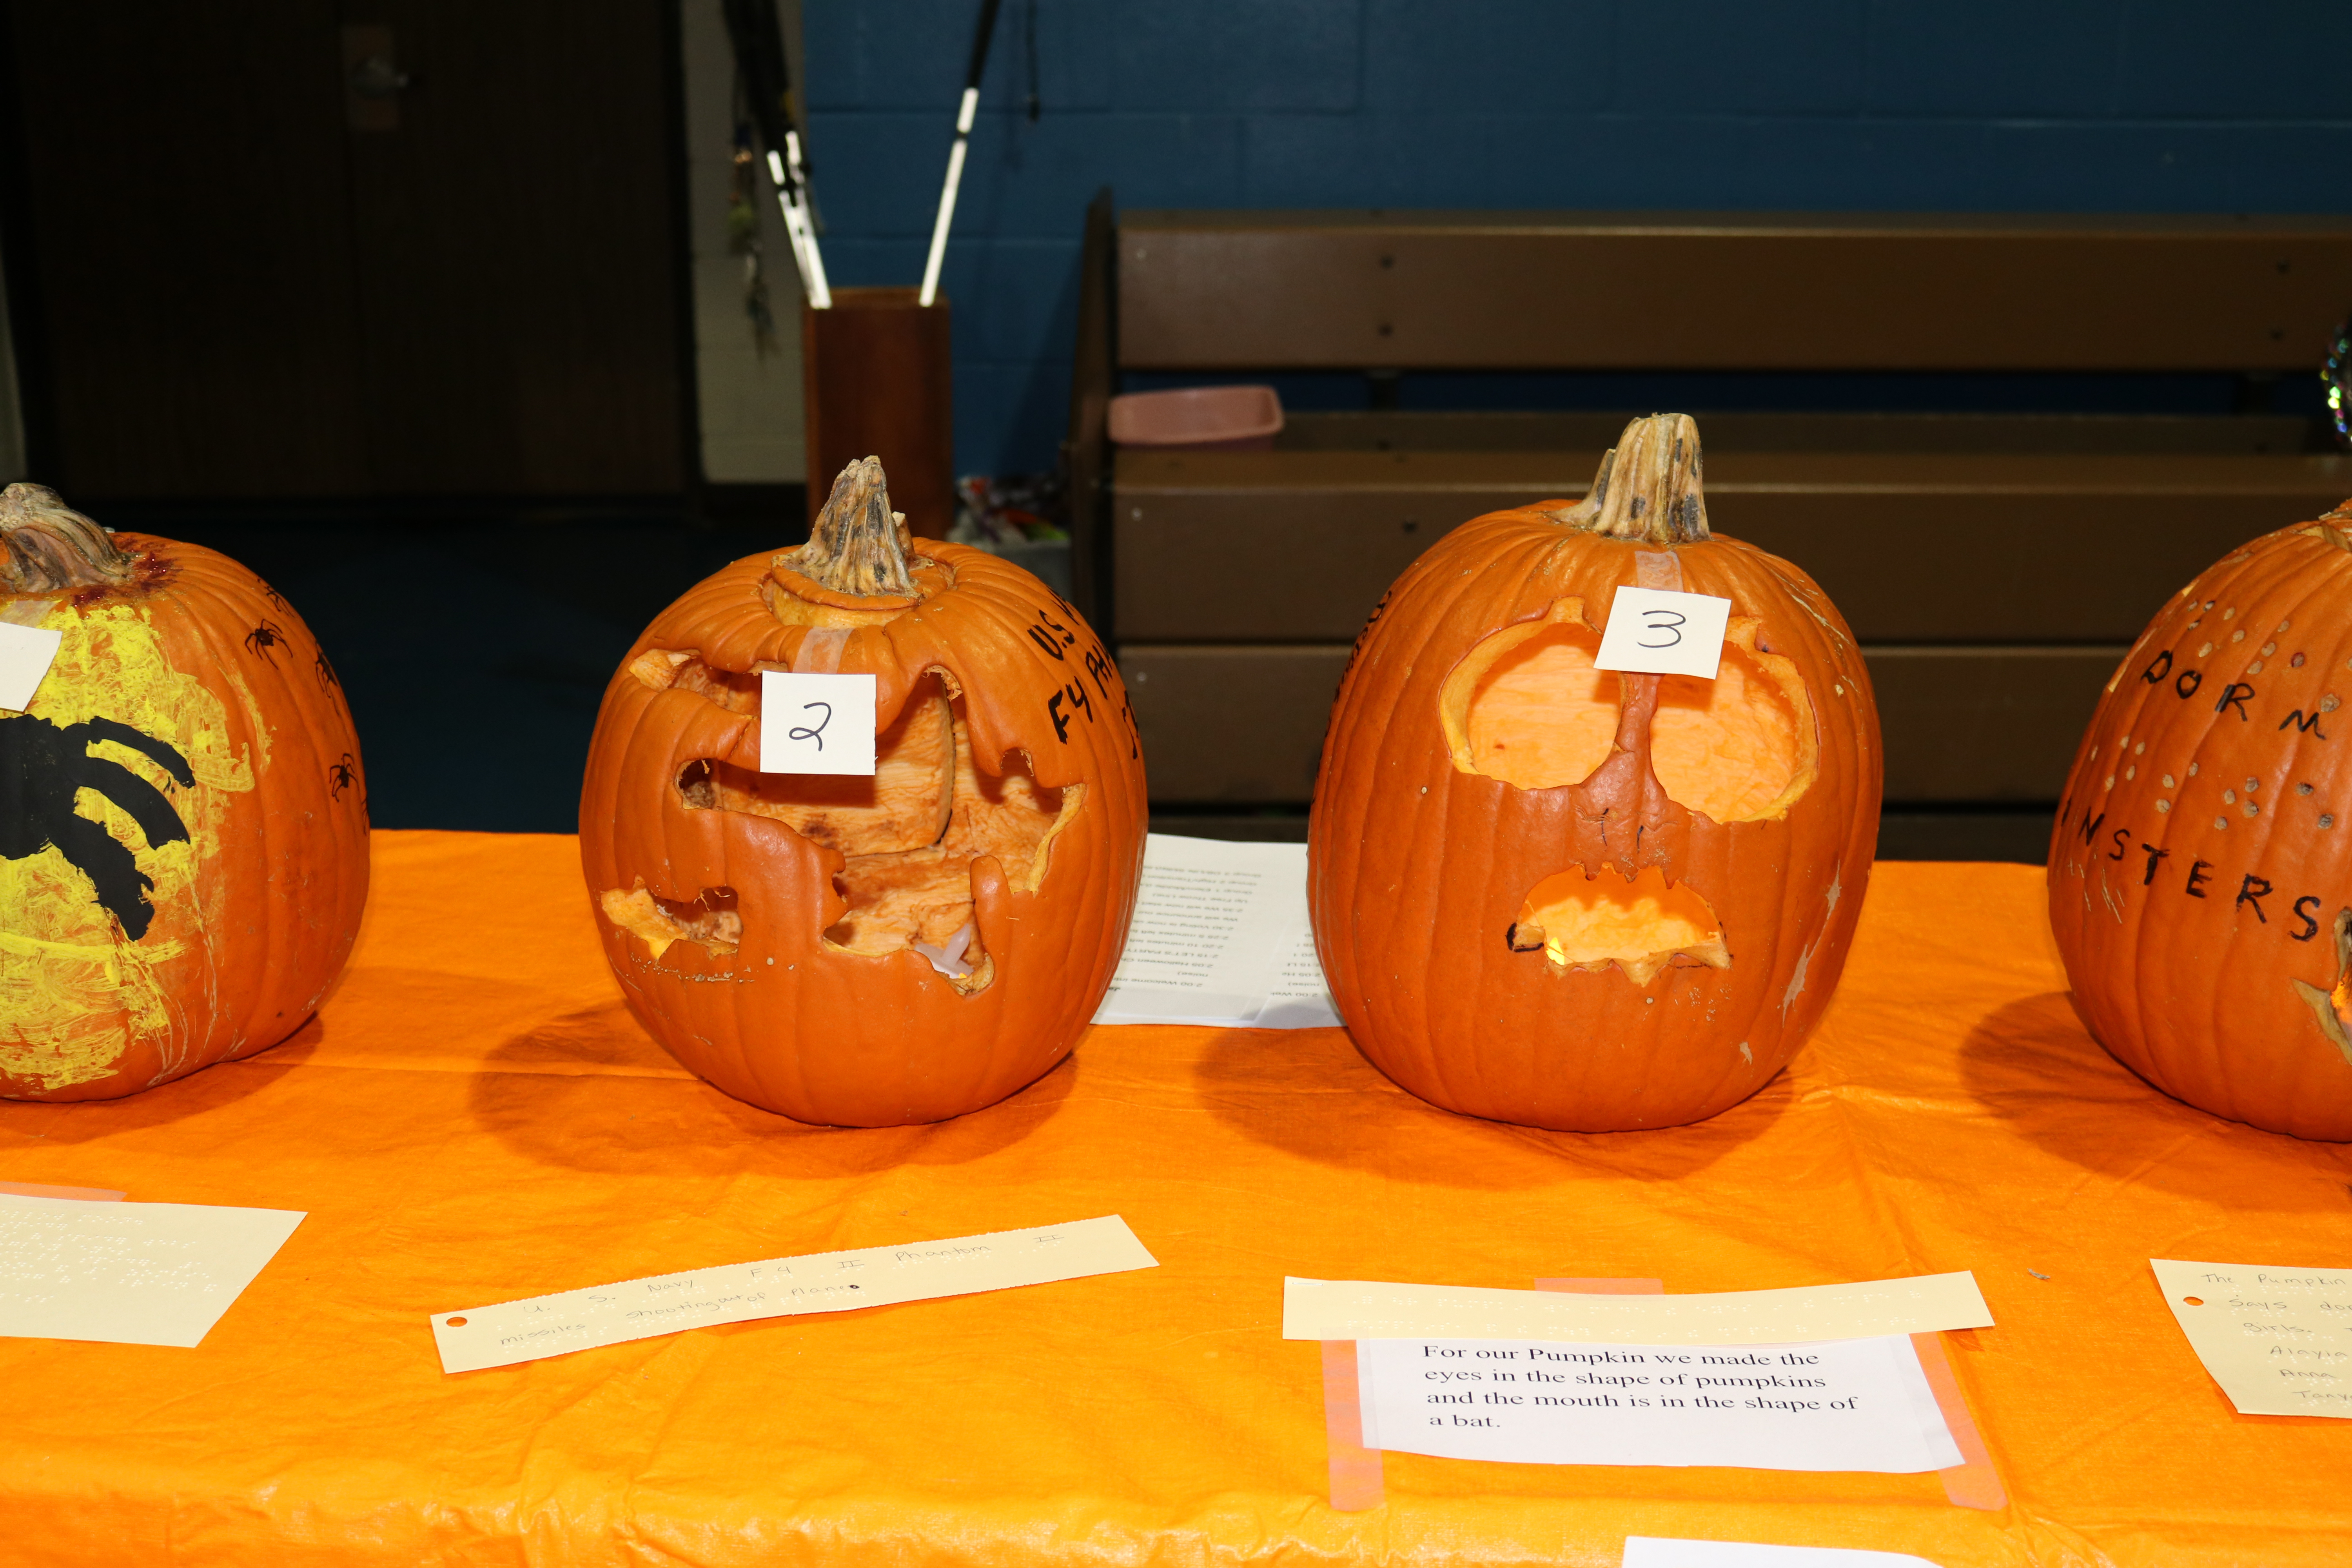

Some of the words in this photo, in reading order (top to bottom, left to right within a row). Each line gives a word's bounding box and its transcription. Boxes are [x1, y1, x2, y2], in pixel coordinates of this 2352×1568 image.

[1636, 610, 1686, 648] 3
[2141, 650, 2327, 740] DORM
[789, 702, 831, 752] 2
[2061, 797, 2321, 941] NSTERS
[647, 1279, 693, 1292] Navy
[895, 1245, 991, 1261] Phantom
[2200, 1273, 2236, 1283] The
[2258, 1274, 2347, 1287] Pumpkin
[500, 1323, 586, 1345] missiles
[2243, 1322, 2313, 1333] girls.
[1422, 1345, 1467, 1358] For
[1476, 1348, 1519, 1359] our
[1528, 1348, 1646, 1366] Pumpkin
[1653, 1355, 1692, 1364] we
[1700, 1354, 1771, 1365] made
[1779, 1353, 1820, 1365] the
[1425, 1371, 1482, 1383] eyes
[1492, 1368, 1517, 1381] in
[1526, 1370, 1566, 1383] the
[1575, 1372, 1650, 1388] shape
[1659, 1373, 1688, 1385] of
[1695, 1375, 1826, 1390] pumpkins
[2279, 1369, 2337, 1378] Anna
[1427, 1391, 1475, 1404] and
[1483, 1392, 1524, 1405] the
[1533, 1394, 1620, 1407] mouth
[1629, 1394, 1650, 1407] is
[1660, 1395, 1686, 1407] in
[1693, 1396, 1735, 1408] the
[1744, 1396, 1821, 1413] shape
[1830, 1396, 1859, 1410] of
[2291, 1390, 2352, 1401] Tany
[1429, 1417, 1444, 1426] a
[1451, 1414, 1501, 1427] bat.
